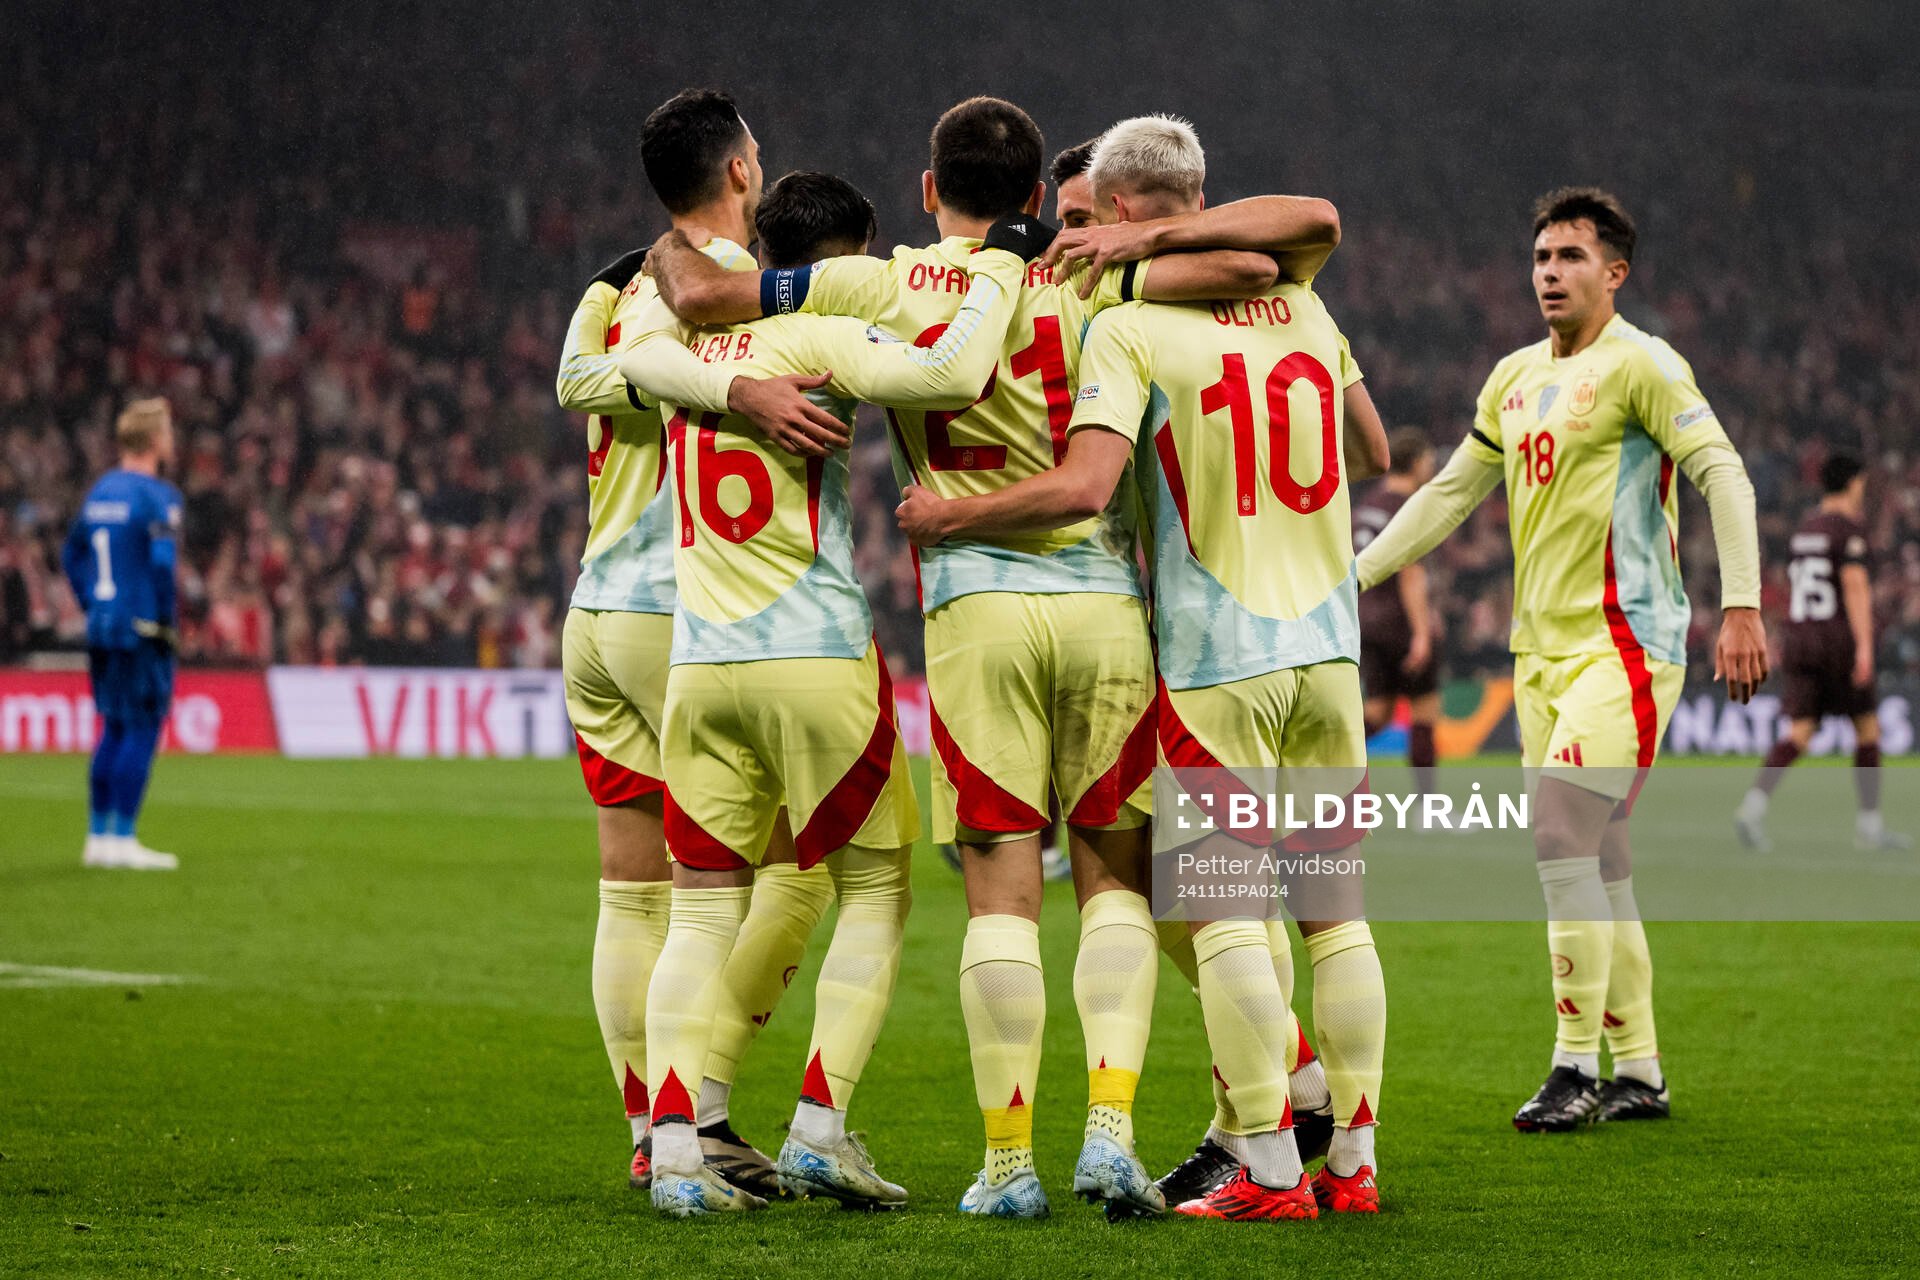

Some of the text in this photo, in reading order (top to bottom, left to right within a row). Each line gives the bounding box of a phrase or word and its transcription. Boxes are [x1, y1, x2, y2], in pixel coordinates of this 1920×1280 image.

[779, 279, 792, 315] RESPE
[1210, 297, 1292, 327] OLMO
[734, 333, 754, 361] B.
[1200, 351, 1340, 517] 10
[1517, 431, 1555, 487] 18
[666, 405, 774, 549] 16
[91, 527, 117, 601] 1
[1787, 556, 1838, 623] 15
